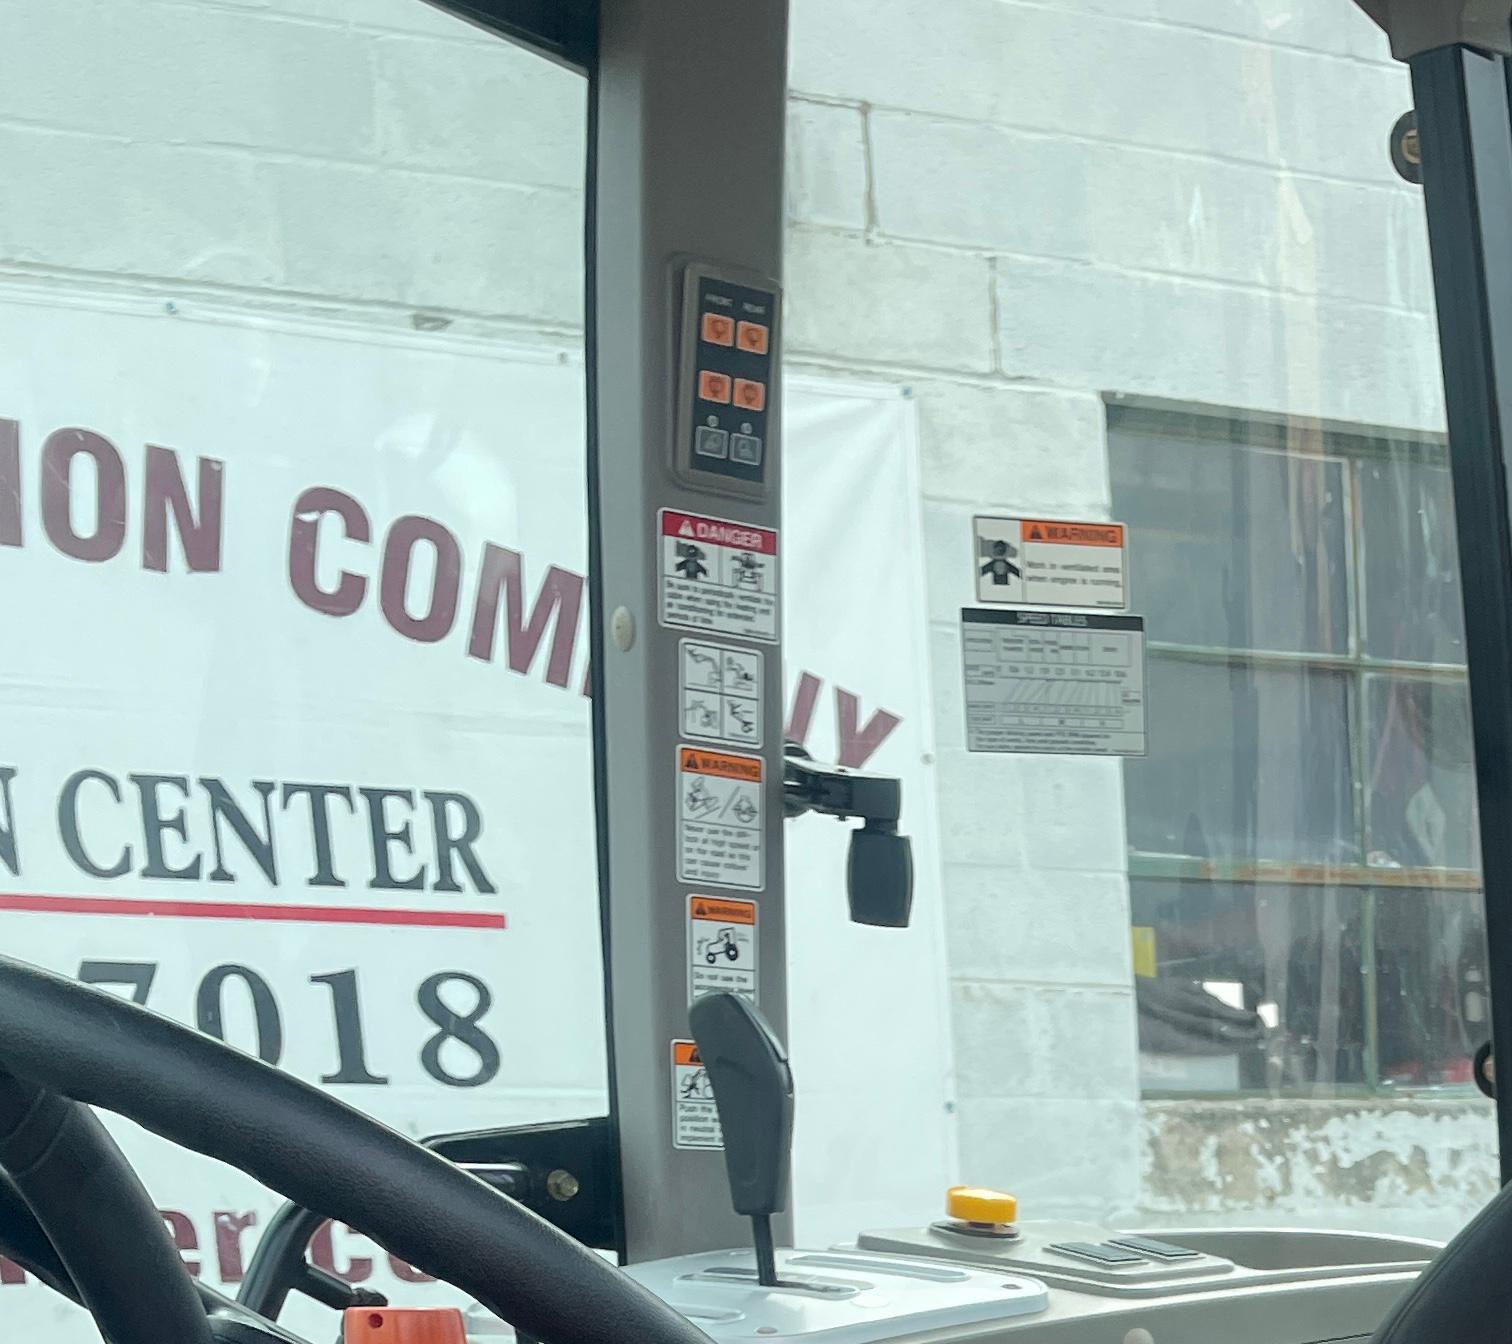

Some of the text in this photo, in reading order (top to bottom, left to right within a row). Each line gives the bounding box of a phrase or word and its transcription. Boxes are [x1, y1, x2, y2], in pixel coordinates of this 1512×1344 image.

[697, 523, 762, 548] DANGER
[1048, 527, 1117, 544] WARNING
[701, 758, 759, 777] WARNING
[57, 769, 497, 895] CENTER
